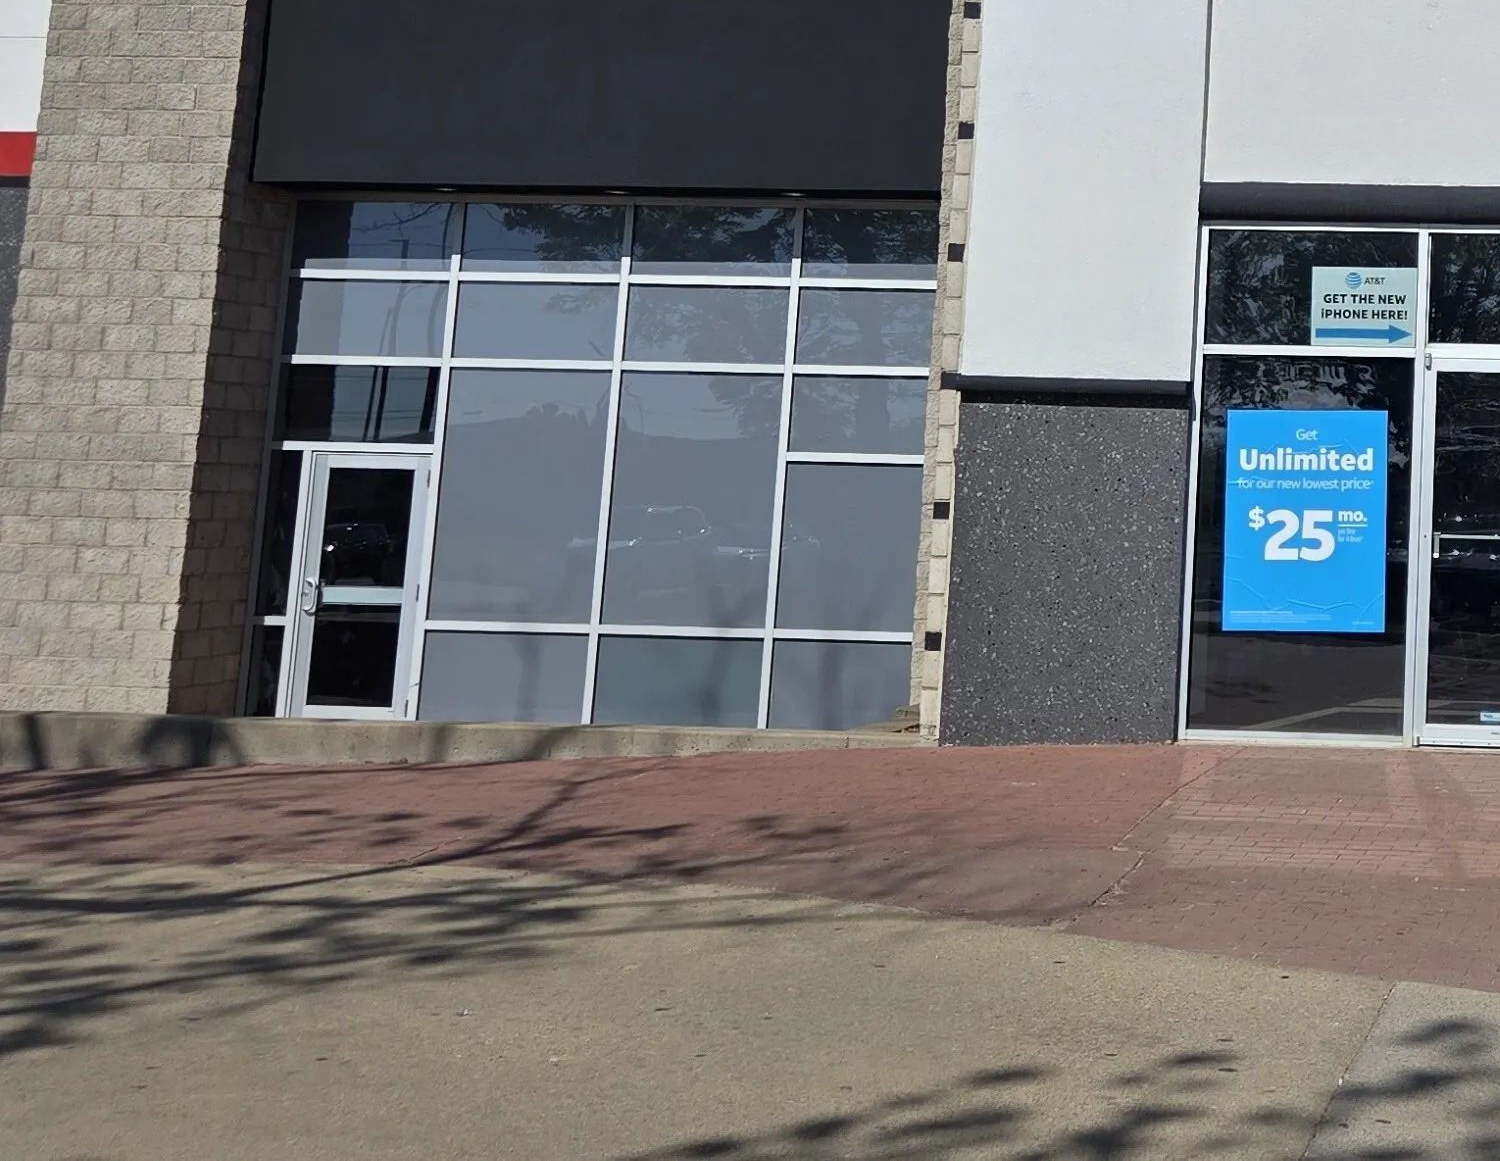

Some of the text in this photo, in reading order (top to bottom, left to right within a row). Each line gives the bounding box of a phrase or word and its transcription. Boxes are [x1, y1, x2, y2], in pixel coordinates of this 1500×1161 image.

[1364, 277, 1386, 285] AT&T
[1323, 294, 1407, 305] GET THE NEW
[1321, 308, 1408, 320] iPHONE HERE!
[1295, 428, 1318, 441] Get
[1239, 447, 1374, 471] Unlimited
[1238, 477, 1254, 489] for
[1256, 479, 1276, 489] our
[1277, 479, 1299, 489] new
[1303, 477, 1339, 489] lowest
[1337, 510, 1368, 522] mo.
